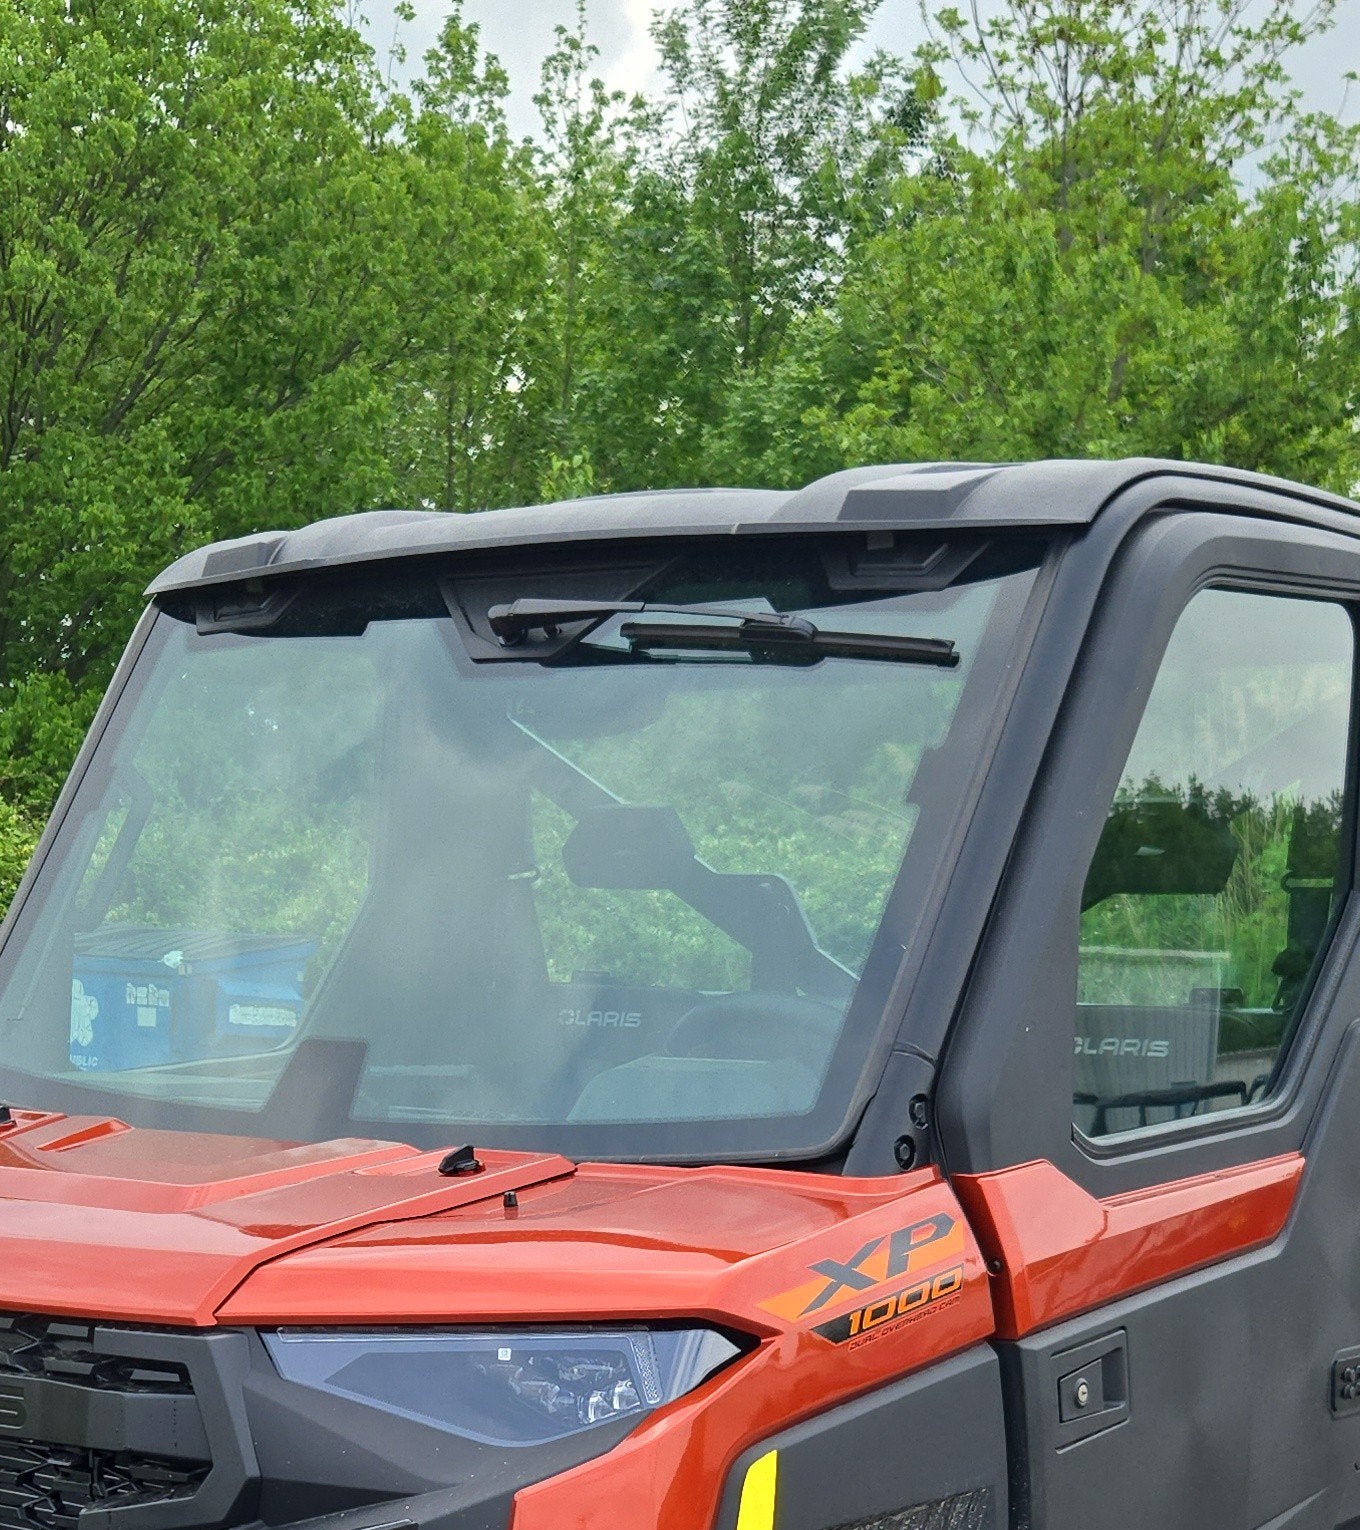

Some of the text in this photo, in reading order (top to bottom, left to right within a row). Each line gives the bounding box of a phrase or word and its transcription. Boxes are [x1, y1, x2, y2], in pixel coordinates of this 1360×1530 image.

[796, 1211, 956, 1317] XP
[848, 1266, 963, 1336] 1000
[848, 1333, 879, 1351] DUAL
[880, 1305, 938, 1336] OVERHEAD
